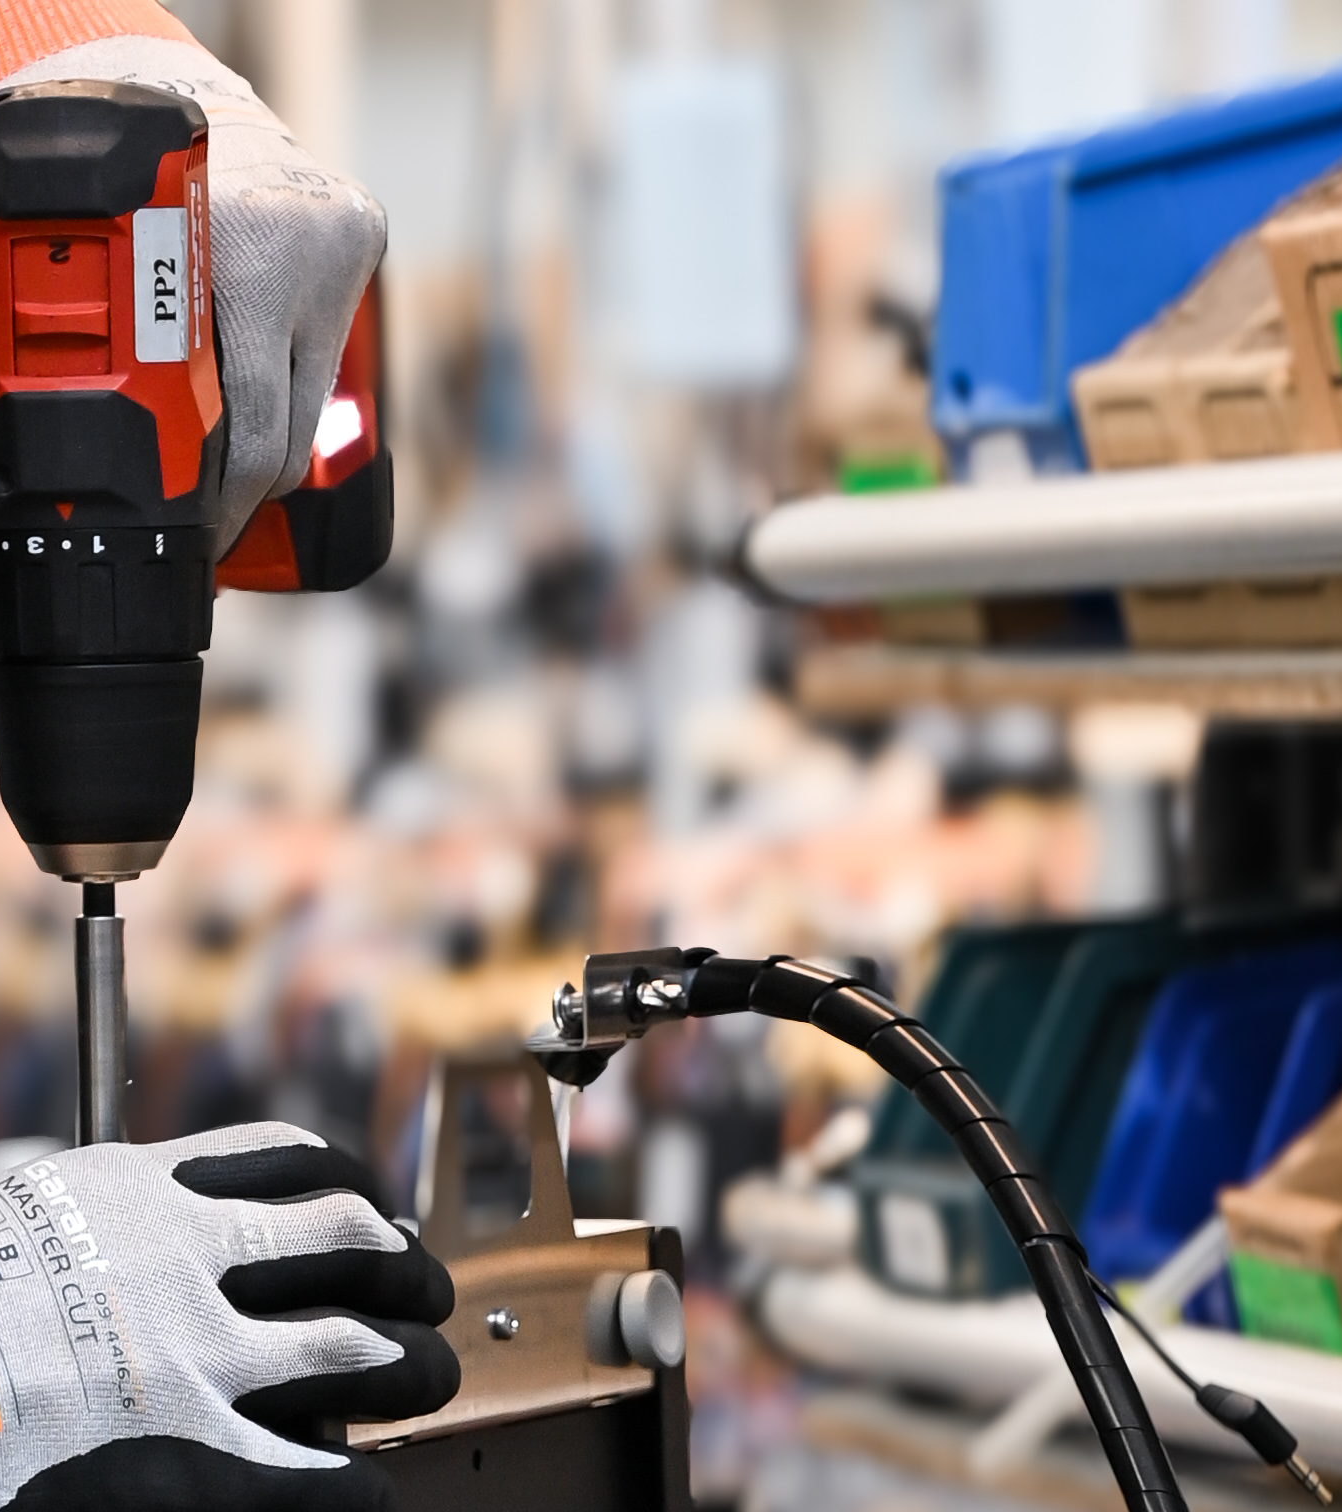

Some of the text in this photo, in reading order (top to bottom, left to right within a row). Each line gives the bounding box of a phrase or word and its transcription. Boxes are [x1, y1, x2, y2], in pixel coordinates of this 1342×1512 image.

[153, 258, 176, 325] PP2
[26, 536, 44, 554] 3
[23, 1159, 110, 1274] Garant
[61, 1283, 99, 1343] CUT
